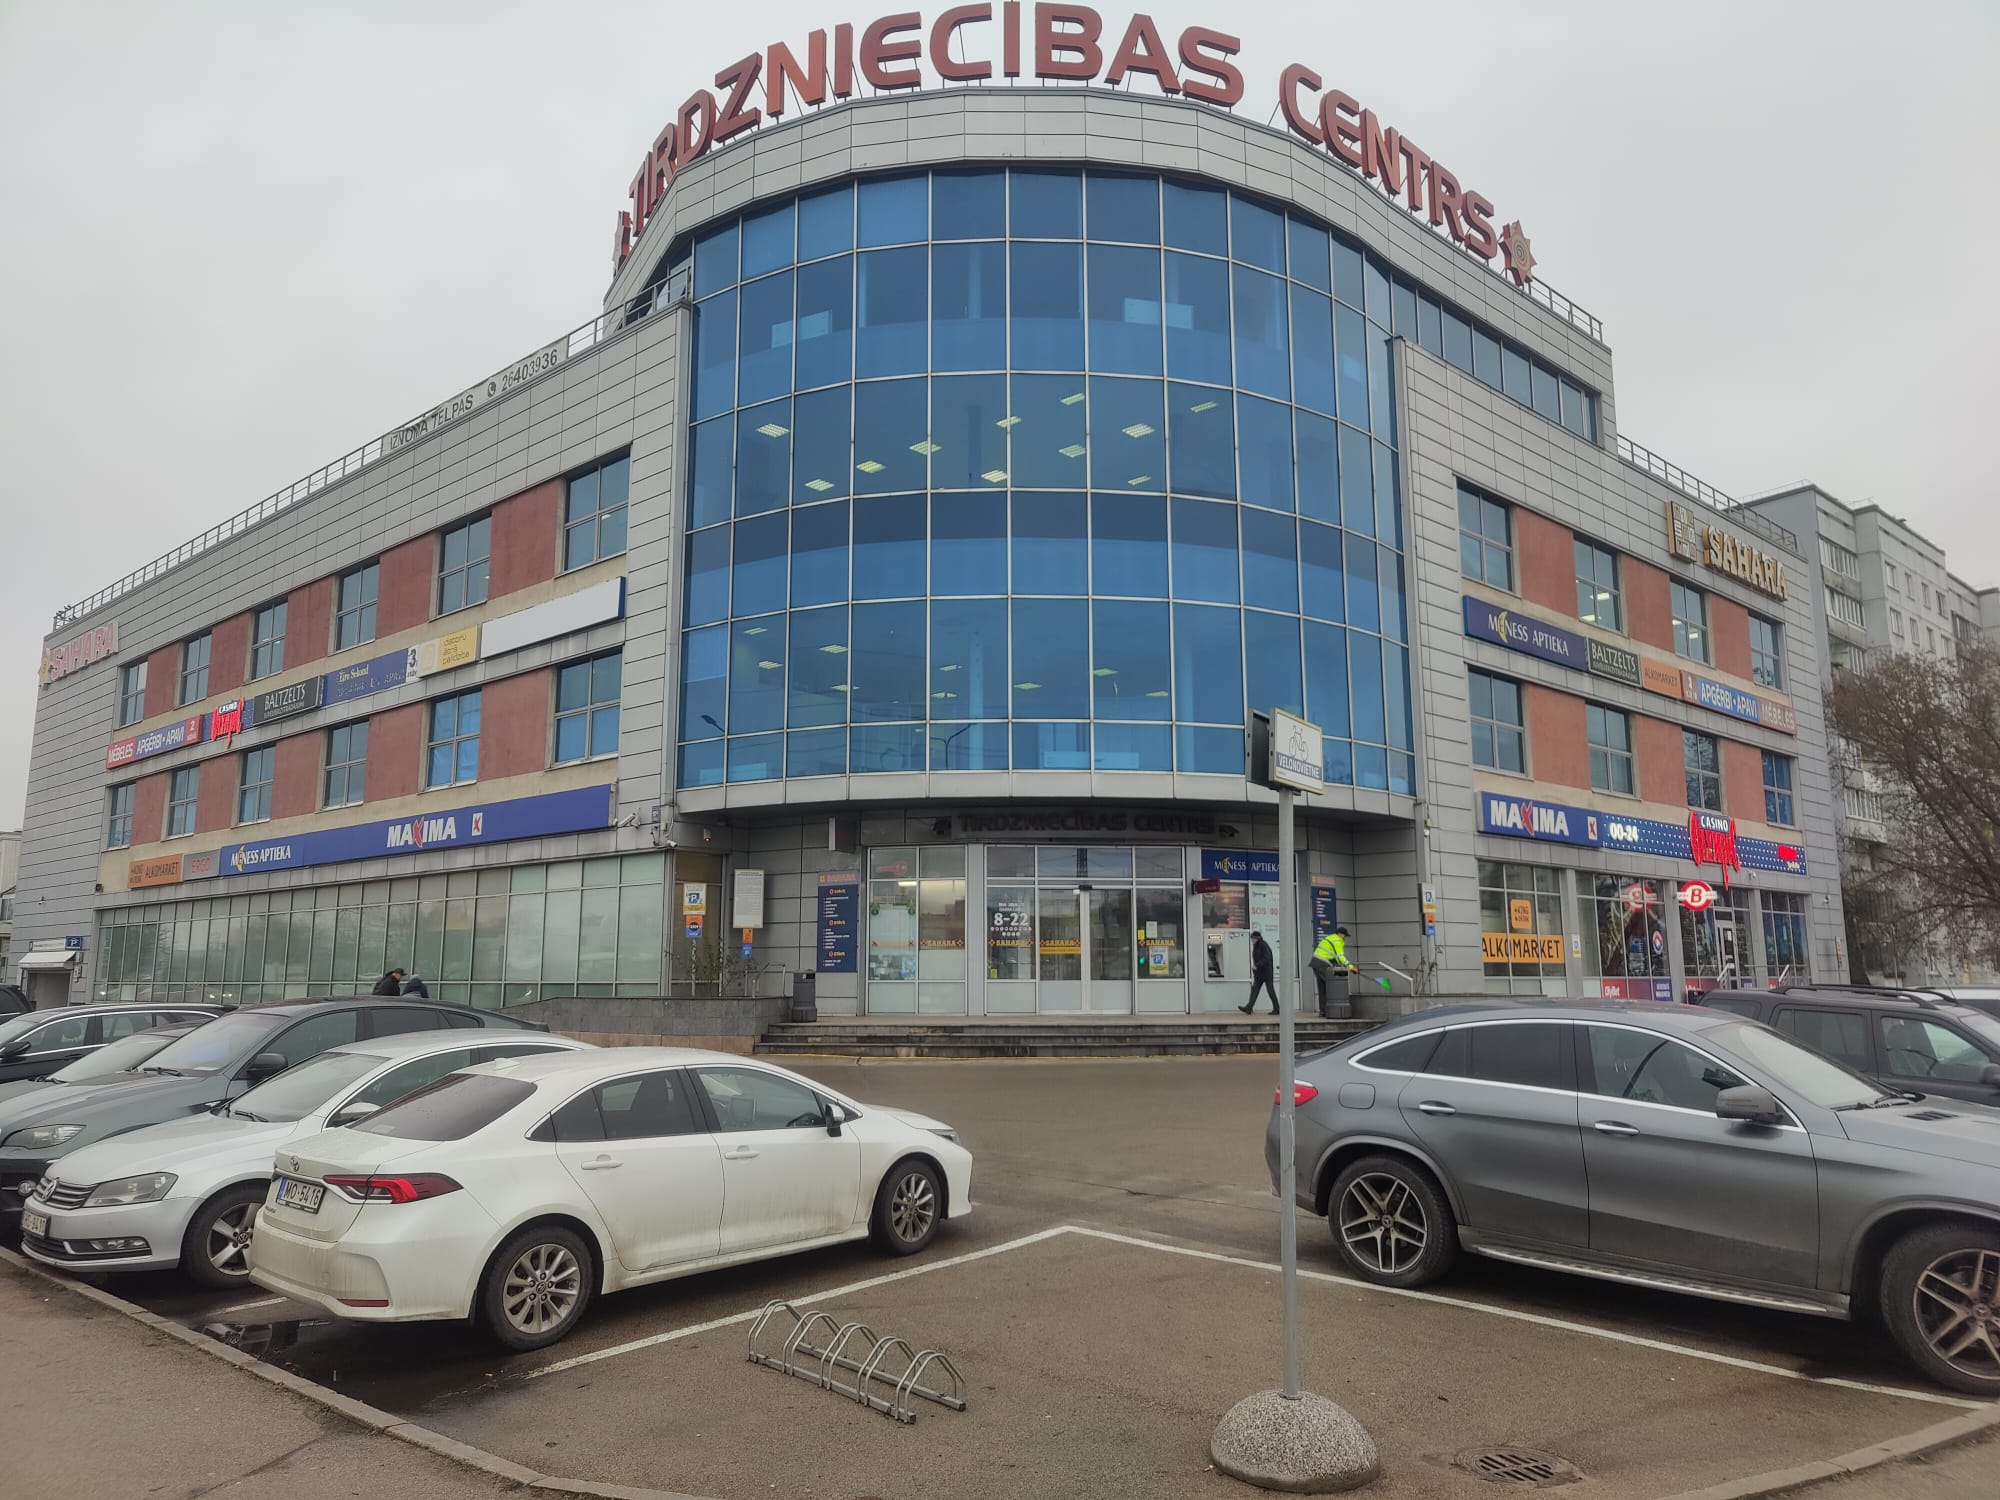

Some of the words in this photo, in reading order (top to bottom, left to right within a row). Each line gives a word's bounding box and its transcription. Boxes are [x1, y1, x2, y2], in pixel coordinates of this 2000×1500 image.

[1278, 63, 1498, 259] CENTRS
[431, 394, 473, 428] TELPAS
[501, 349, 558, 393] 26403936
[1702, 524, 1788, 600] SAHARA
[1532, 630, 1569, 656] APTIEKA
[408, 648, 416, 668] 3
[1591, 643, 1636, 672] BALTZELTS
[264, 683, 306, 711] BALTZELTS
[1737, 695, 1758, 719] APAVI
[165, 726, 185, 746] APAVI
[1490, 800, 1569, 837] MAXIMA
[1700, 815, 1729, 831] CASINO
[386, 816, 457, 848] MAXIMA
[1609, 822, 1639, 842] 00-24
[259, 845, 291, 862] APTIEKA
[993, 912, 1030, 926] 8-22
[1481, 937, 1560, 959] ALKOMARKET
